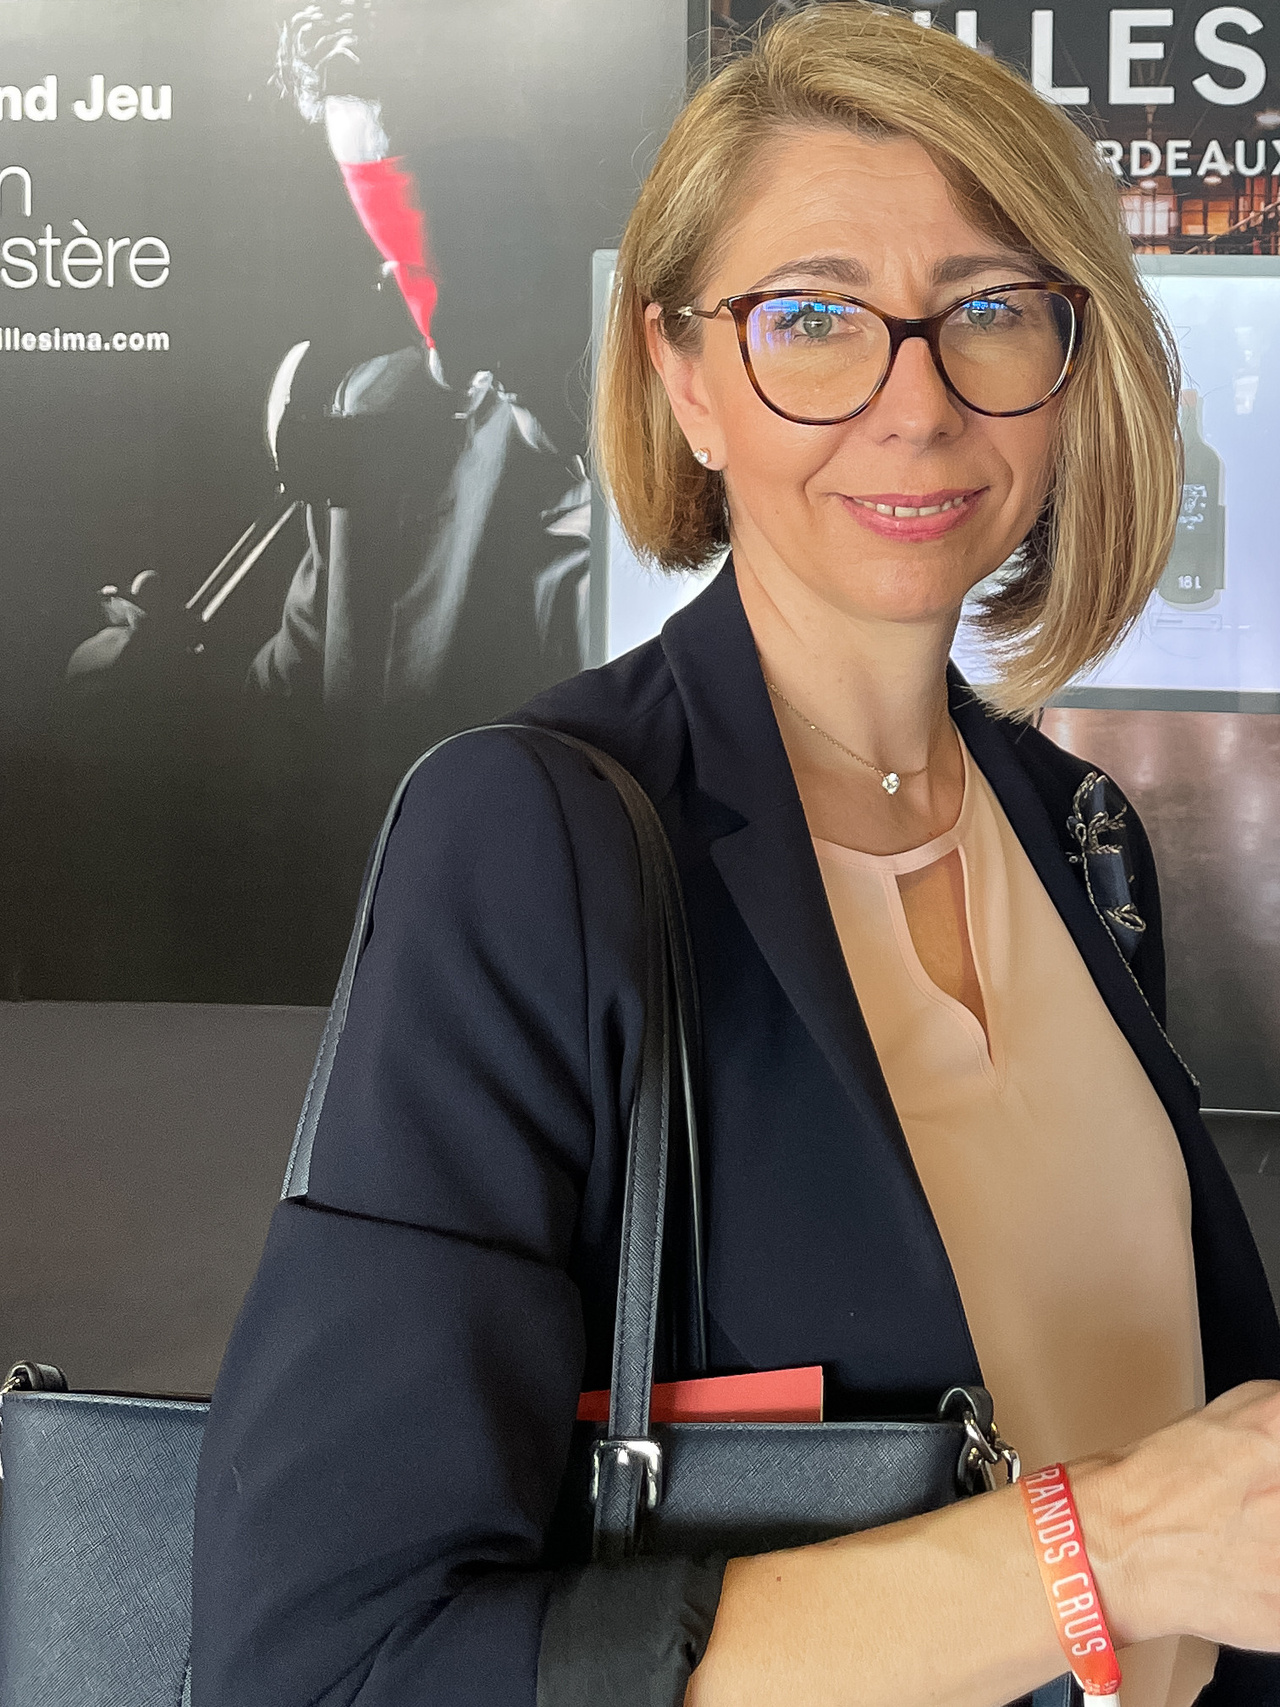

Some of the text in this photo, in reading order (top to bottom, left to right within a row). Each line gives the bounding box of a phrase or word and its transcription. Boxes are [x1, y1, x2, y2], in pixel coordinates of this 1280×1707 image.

[0, 74, 172, 121] nd Jeu
[1, 218, 171, 289] stère
[1052, 1572, 1107, 1656] CRUS
